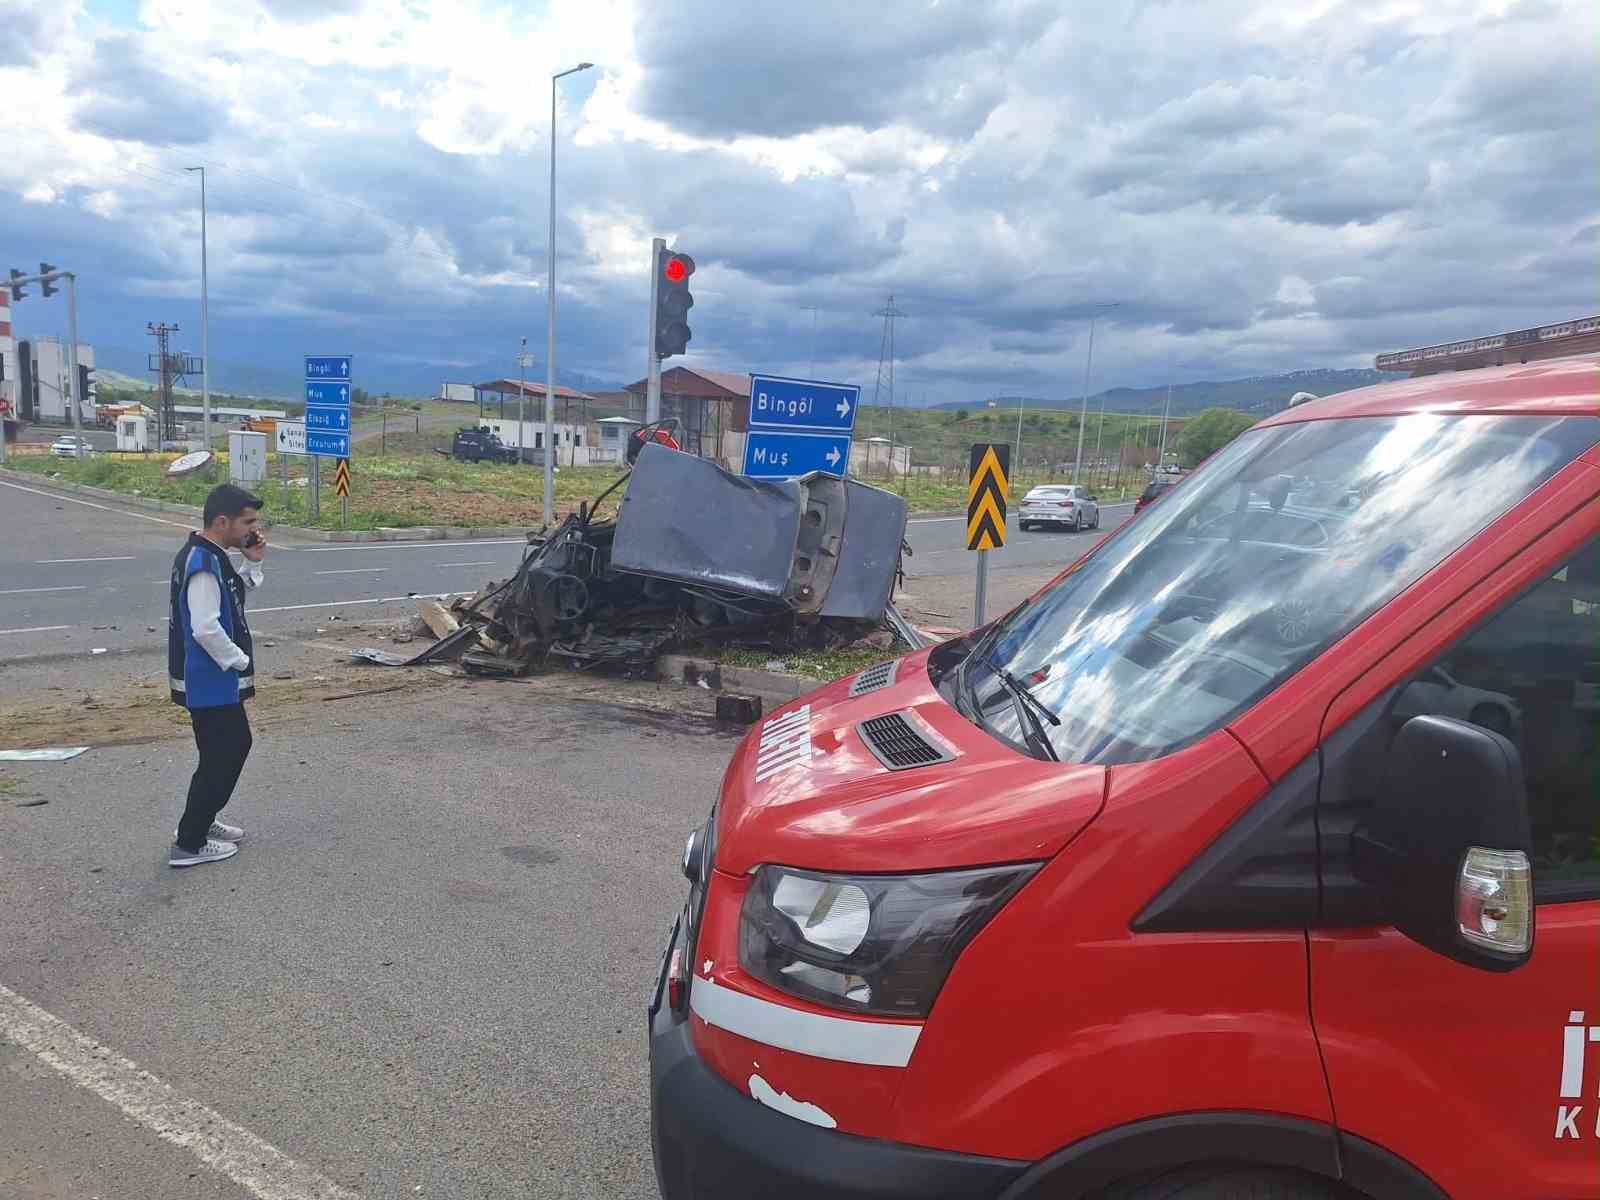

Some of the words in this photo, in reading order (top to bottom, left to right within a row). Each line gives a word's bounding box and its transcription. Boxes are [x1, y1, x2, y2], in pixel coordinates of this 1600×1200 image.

[758, 393, 813, 416] Bingöl
[753, 447, 788, 467] Muş
[1560, 1010, 1600, 1097] İ
[1555, 1105, 1600, 1138] K
